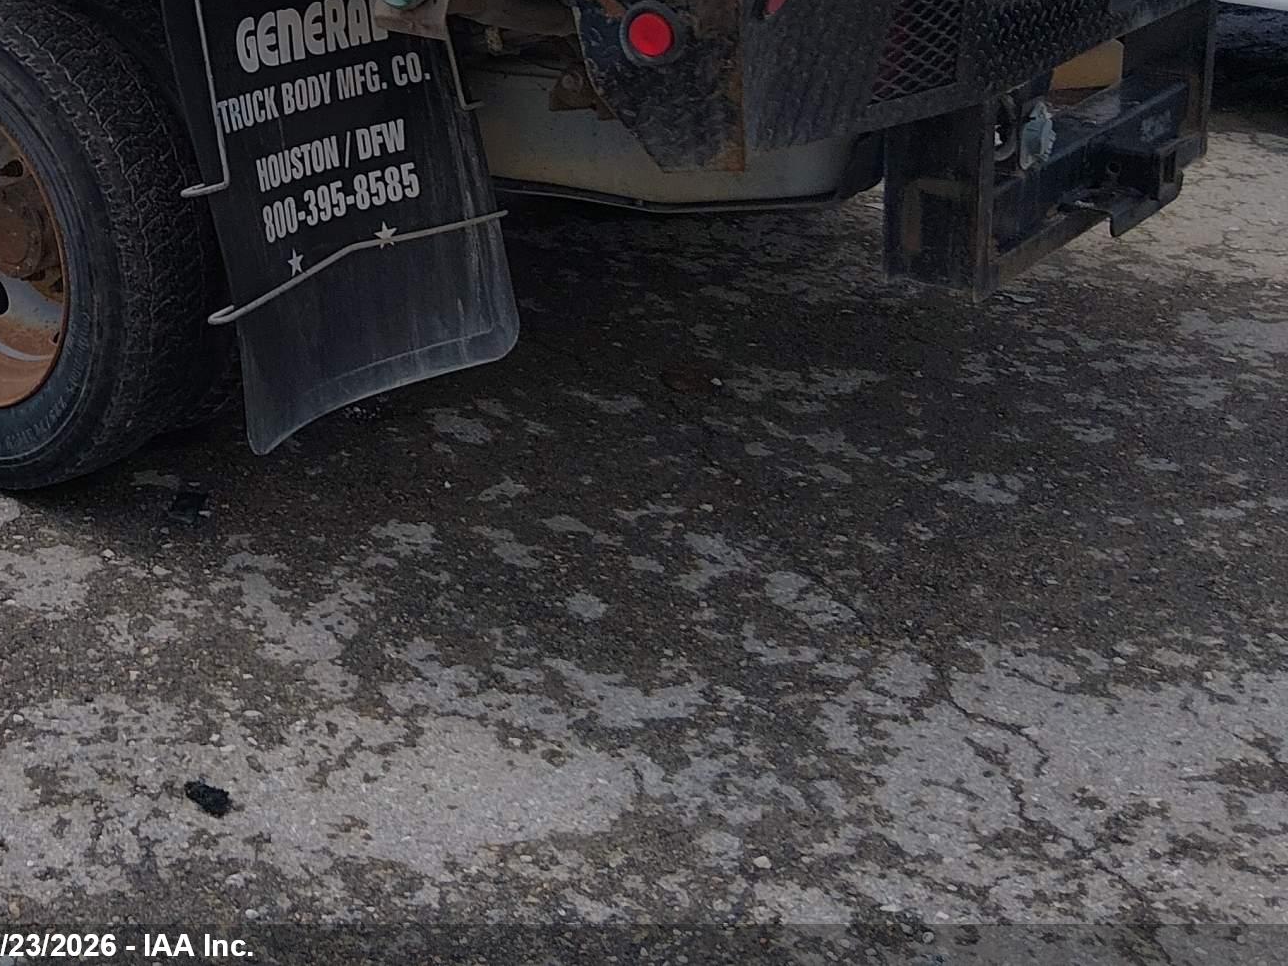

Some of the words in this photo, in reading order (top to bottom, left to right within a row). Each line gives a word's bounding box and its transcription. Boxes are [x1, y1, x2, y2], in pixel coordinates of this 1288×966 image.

[217, 86, 279, 134] TRUCK
[281, 71, 331, 115] BODY
[336, 61, 387, 100] MFG.
[391, 52, 431, 86] CO.
[256, 135, 340, 192] HOUSTON
[344, 131, 351, 168] /
[355, 118, 405, 160] DFW
[262, 162, 420, 243] 800-395-8585
